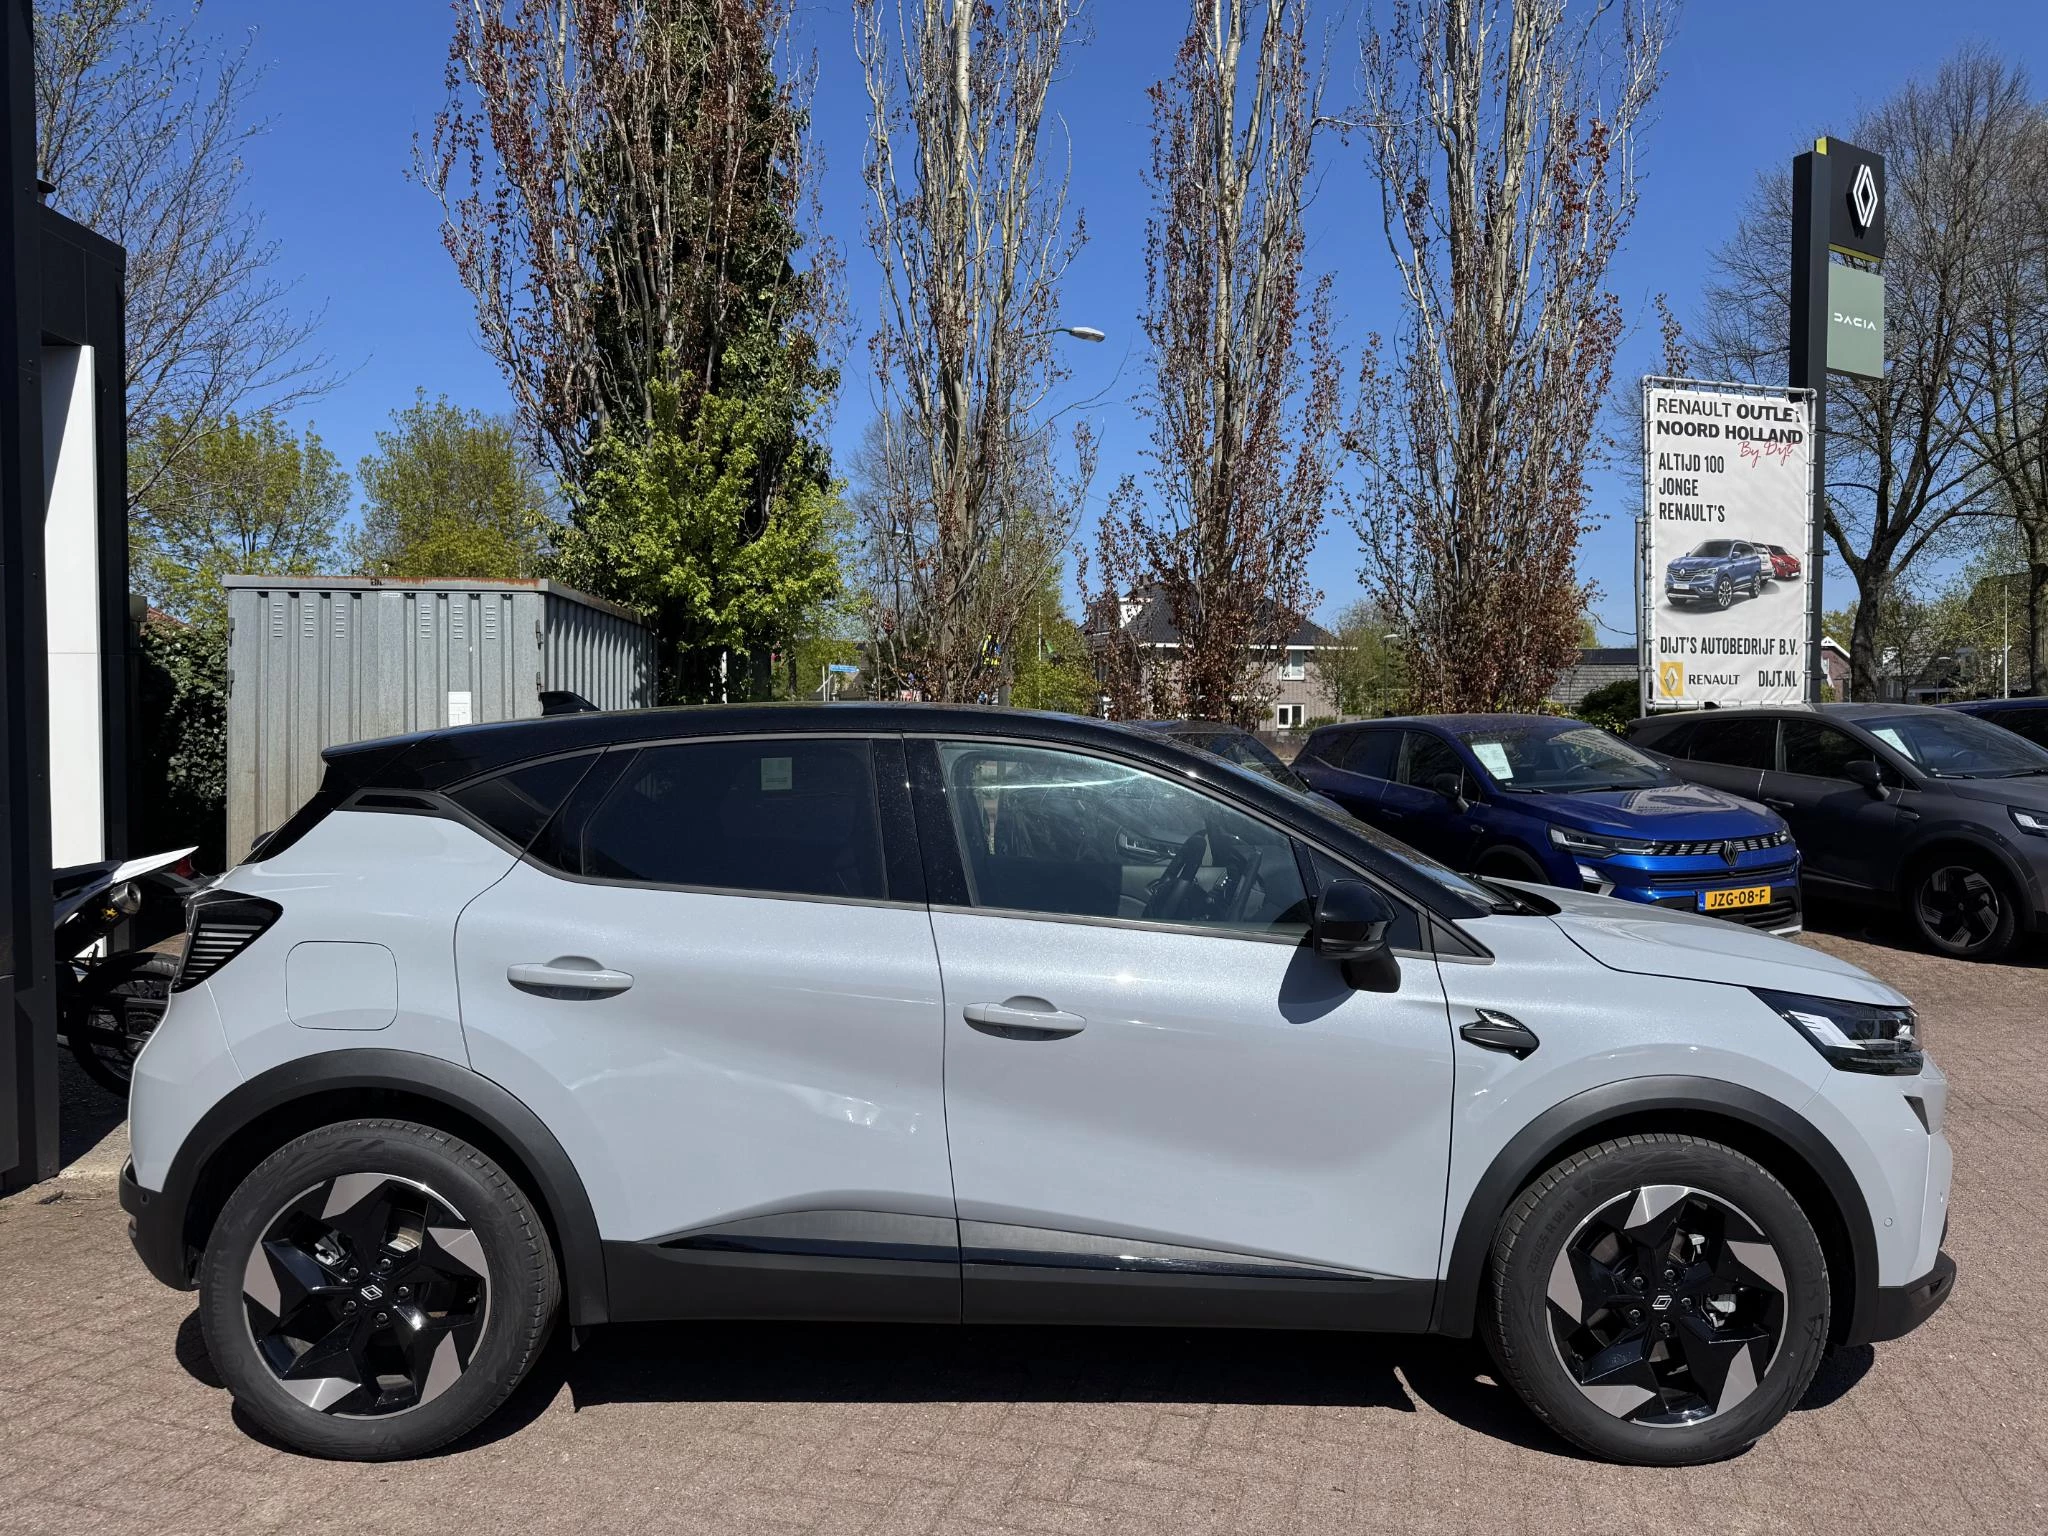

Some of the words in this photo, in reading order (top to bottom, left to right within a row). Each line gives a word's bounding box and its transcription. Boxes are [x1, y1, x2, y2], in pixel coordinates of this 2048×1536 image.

[1833, 312, 1876, 331] DACIA
[1657, 397, 1732, 418] RENAULT
[1657, 420, 1720, 438] NOORD
[1725, 424, 1803, 444] HOLLAND
[1659, 453, 1700, 471] ALTIJD
[1704, 455, 1725, 474] 100
[1738, 441, 1761, 468] By
[1659, 478, 1699, 496] JONGE
[1659, 502, 1725, 522] RENAULT'S
[1660, 636, 1697, 654] DIJT'S
[1701, 637, 1775, 655] AUTOBEDRIJF
[1779, 638, 1798, 655] B.V.
[1688, 674, 1740, 685] RENAULT
[1758, 670, 1797, 687] DIJT.NL
[1711, 889, 1766, 907] JZG-08-F
